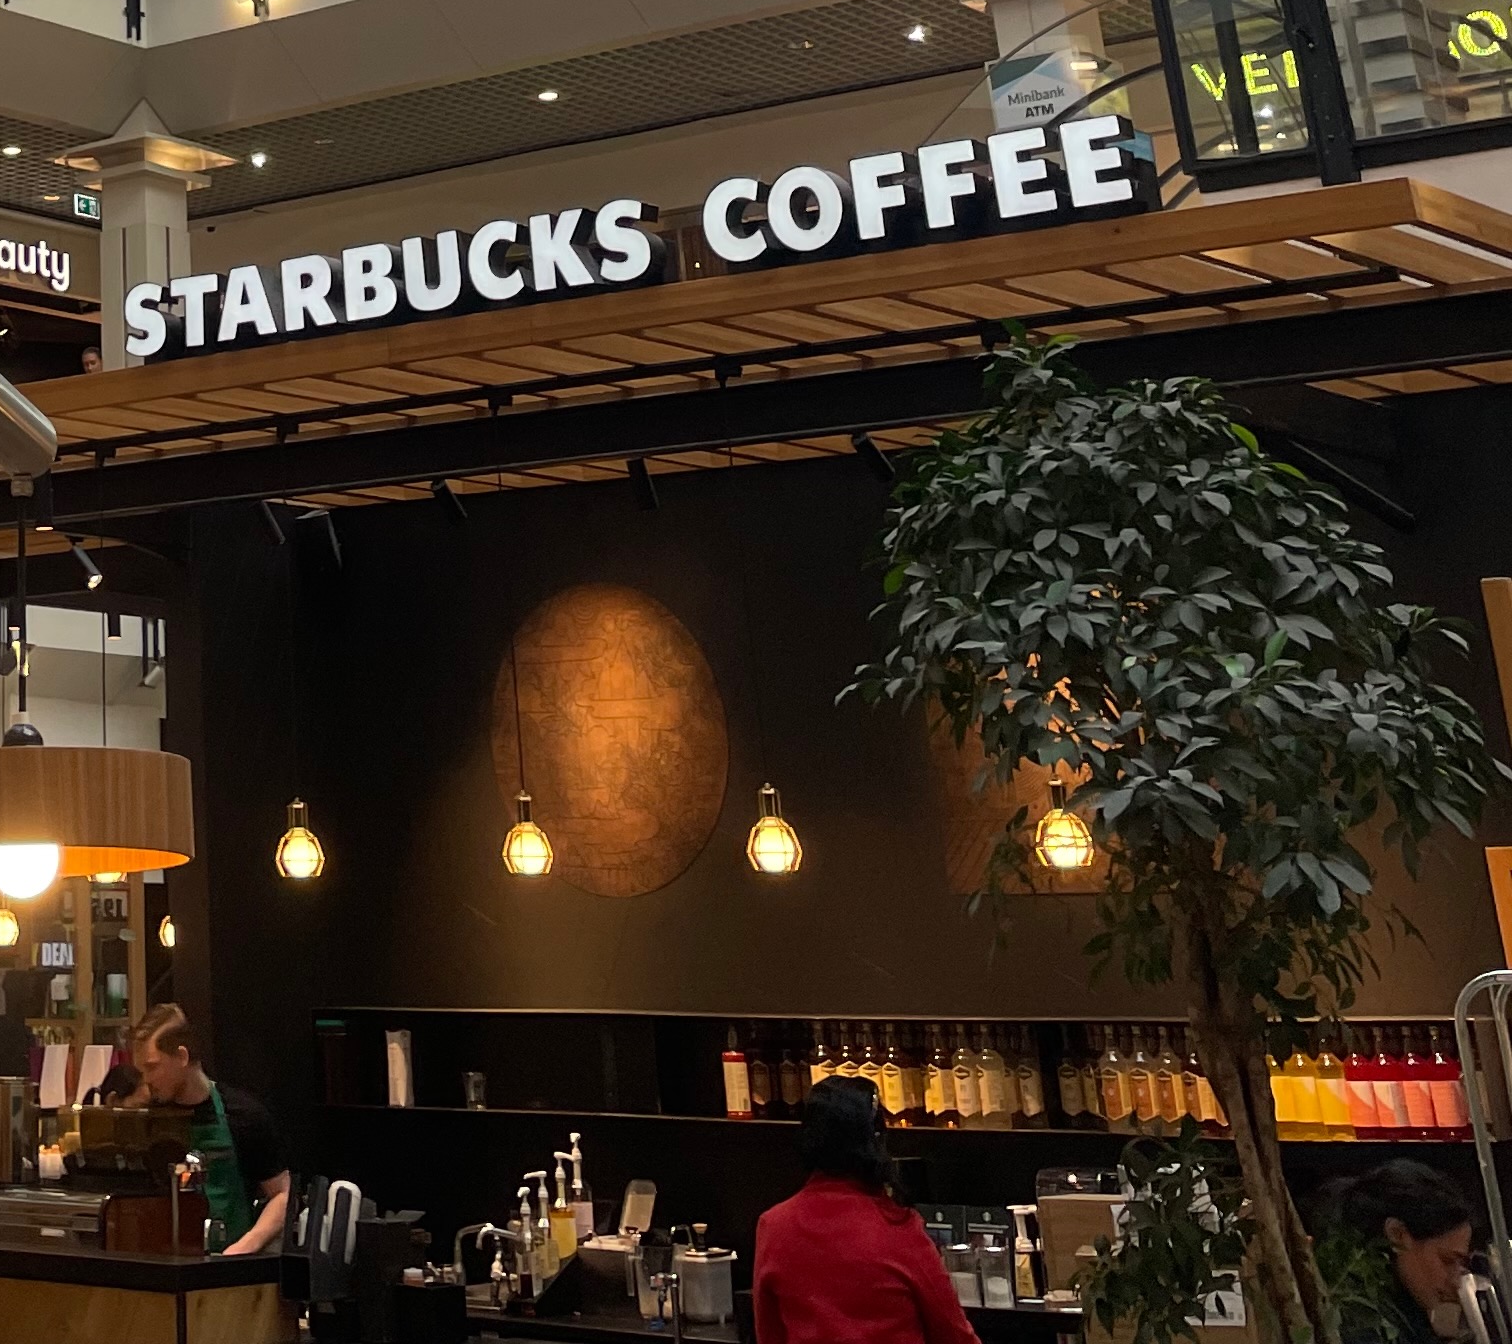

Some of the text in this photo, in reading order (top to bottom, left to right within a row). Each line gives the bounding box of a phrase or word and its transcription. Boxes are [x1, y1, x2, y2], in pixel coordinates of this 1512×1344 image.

[1007, 85, 1066, 107] Minibank
[1025, 103, 1055, 119] ATM
[124, 114, 1135, 358] STARBUCKS COFFEE
